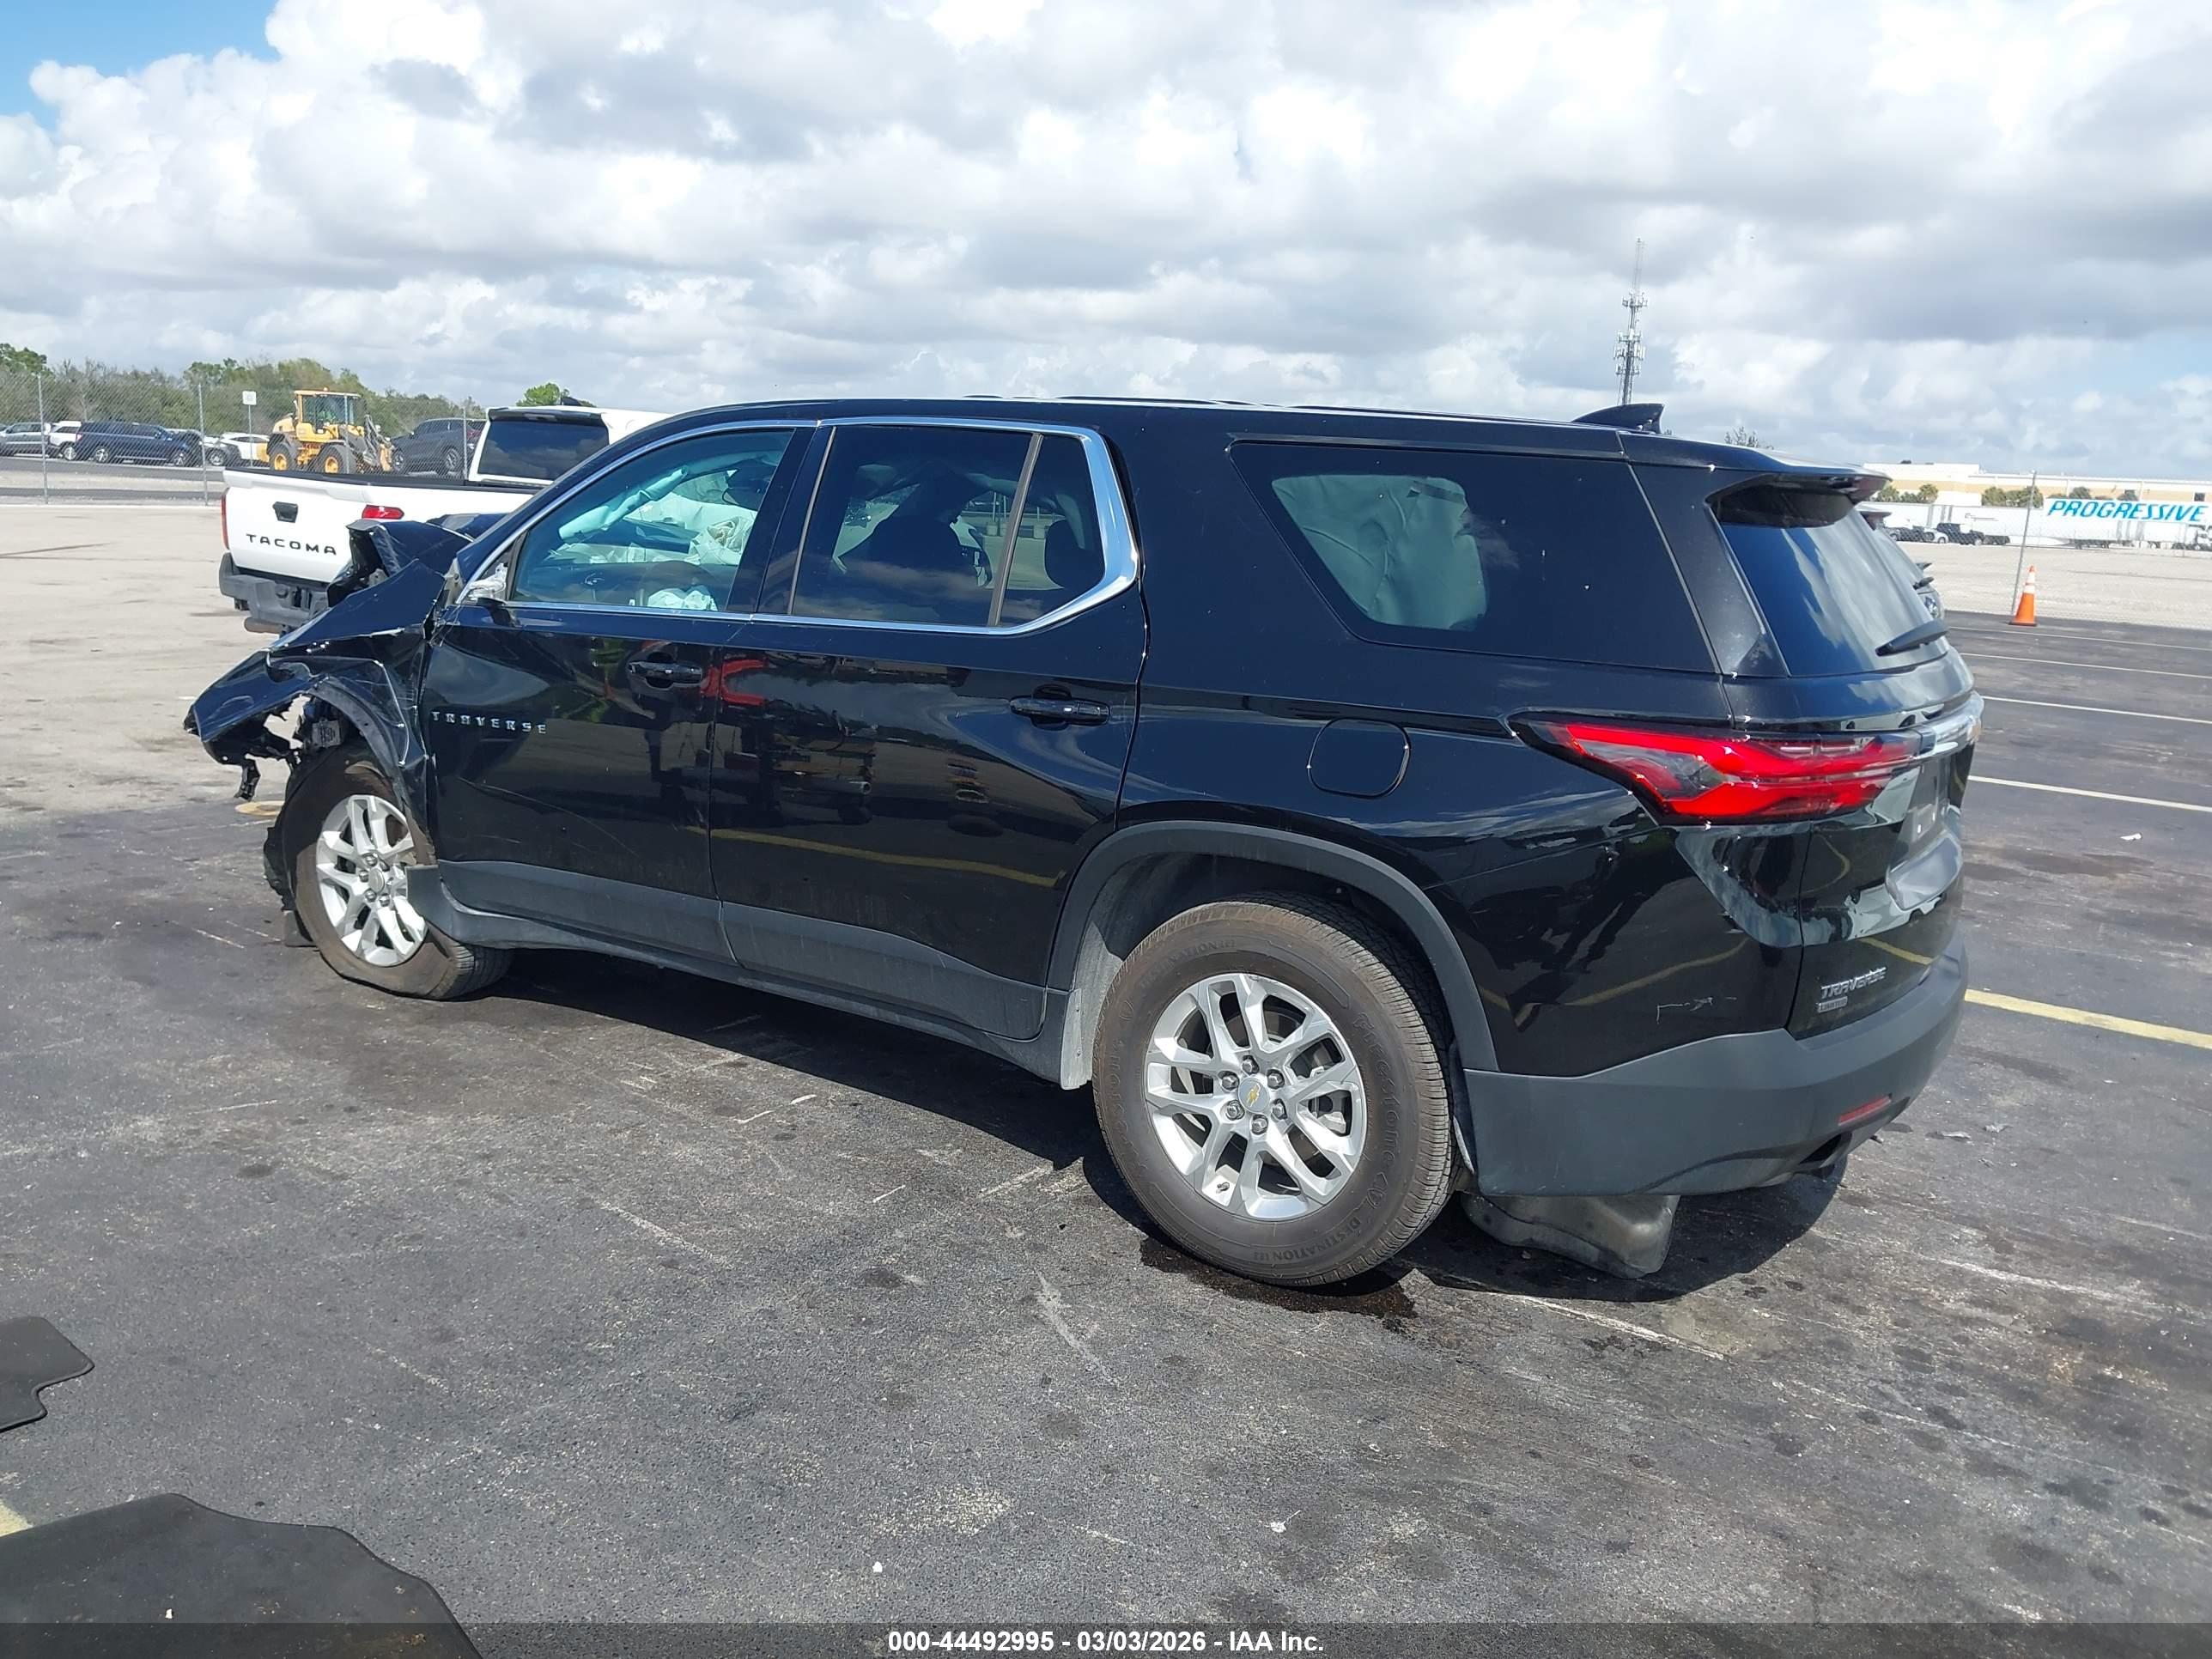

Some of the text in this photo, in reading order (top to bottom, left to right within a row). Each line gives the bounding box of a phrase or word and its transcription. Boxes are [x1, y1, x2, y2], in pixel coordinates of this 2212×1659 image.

[2047, 500, 2209, 522] PROGRESSIVE
[246, 533, 337, 556] TACOMA
[431, 711, 547, 734] TRAVERSE
[1820, 967, 1887, 999] TRAVERSE
